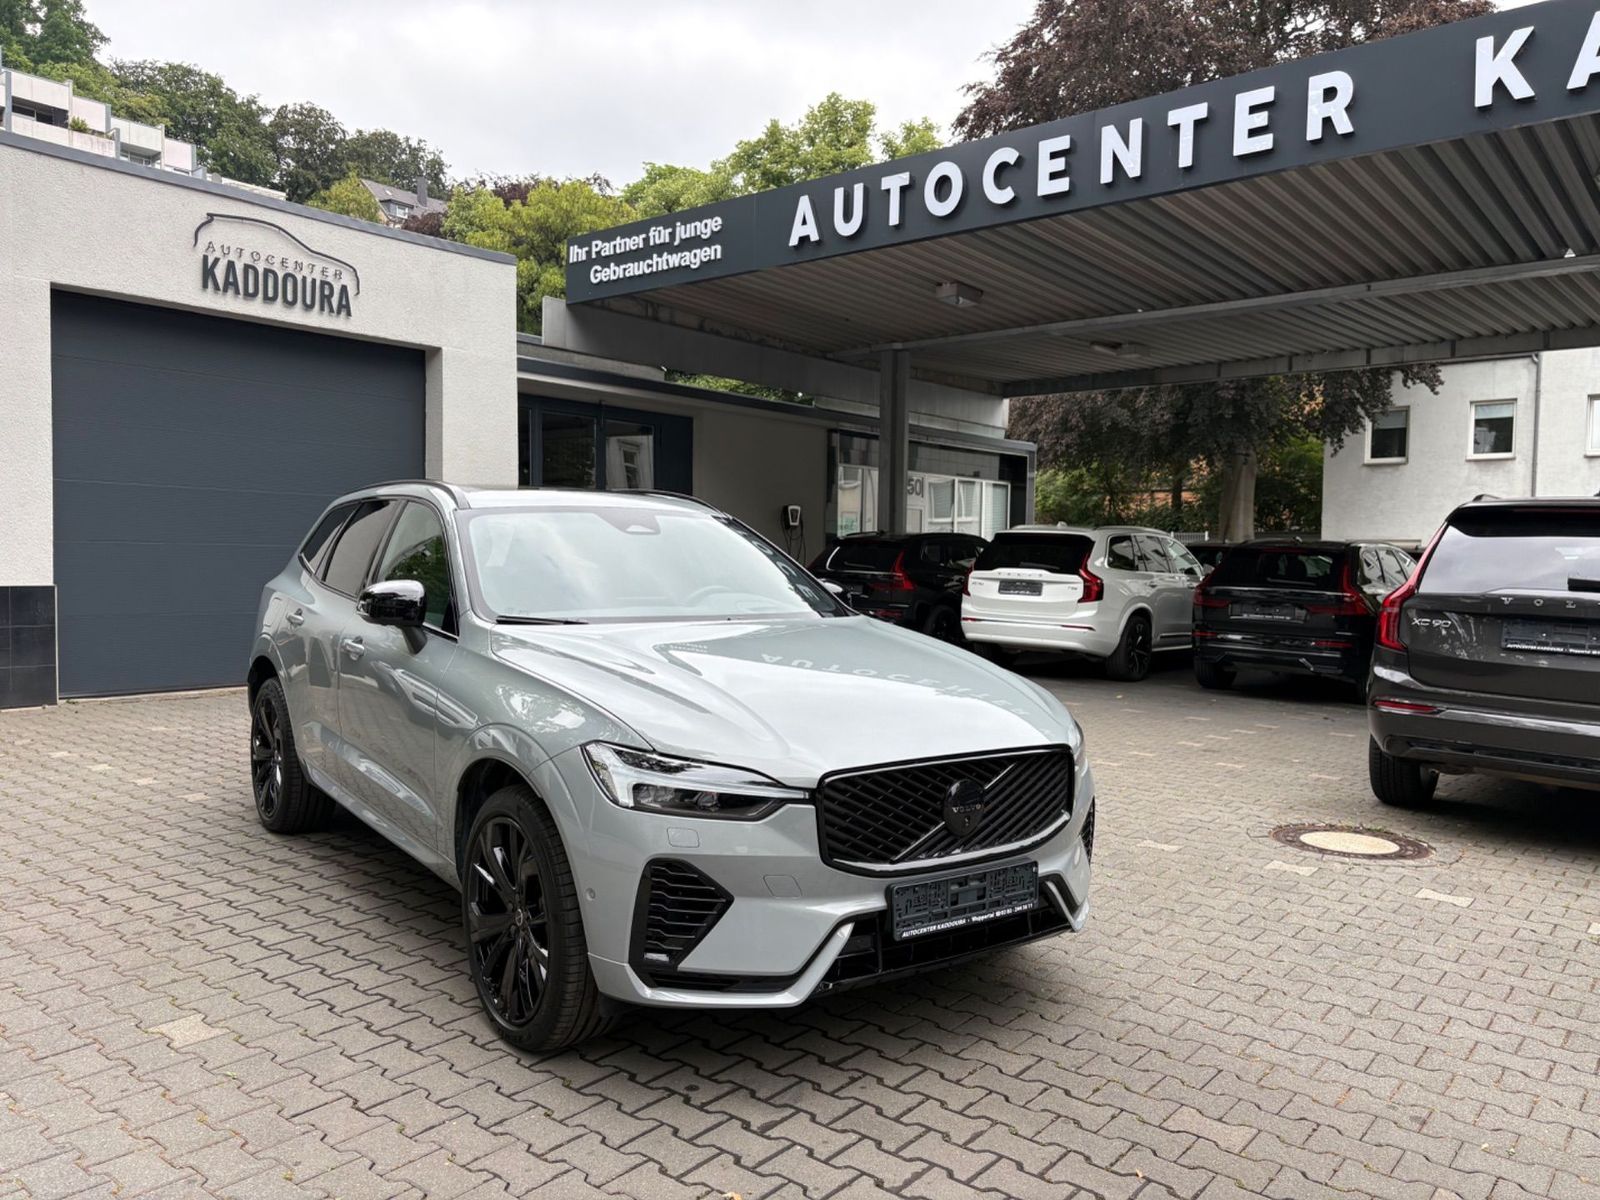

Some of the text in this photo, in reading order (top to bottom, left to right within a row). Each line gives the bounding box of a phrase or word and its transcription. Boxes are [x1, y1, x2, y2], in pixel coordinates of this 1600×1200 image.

[788, 71, 1354, 247] AUTOCENTER
[206, 240, 343, 281] AUTOCENTER
[569, 215, 722, 263] Ihr Partner für junge
[202, 253, 352, 318] KADDOURA
[590, 243, 722, 284] Gebrauchtwagen
[1500, 596, 1600, 609] VOL
